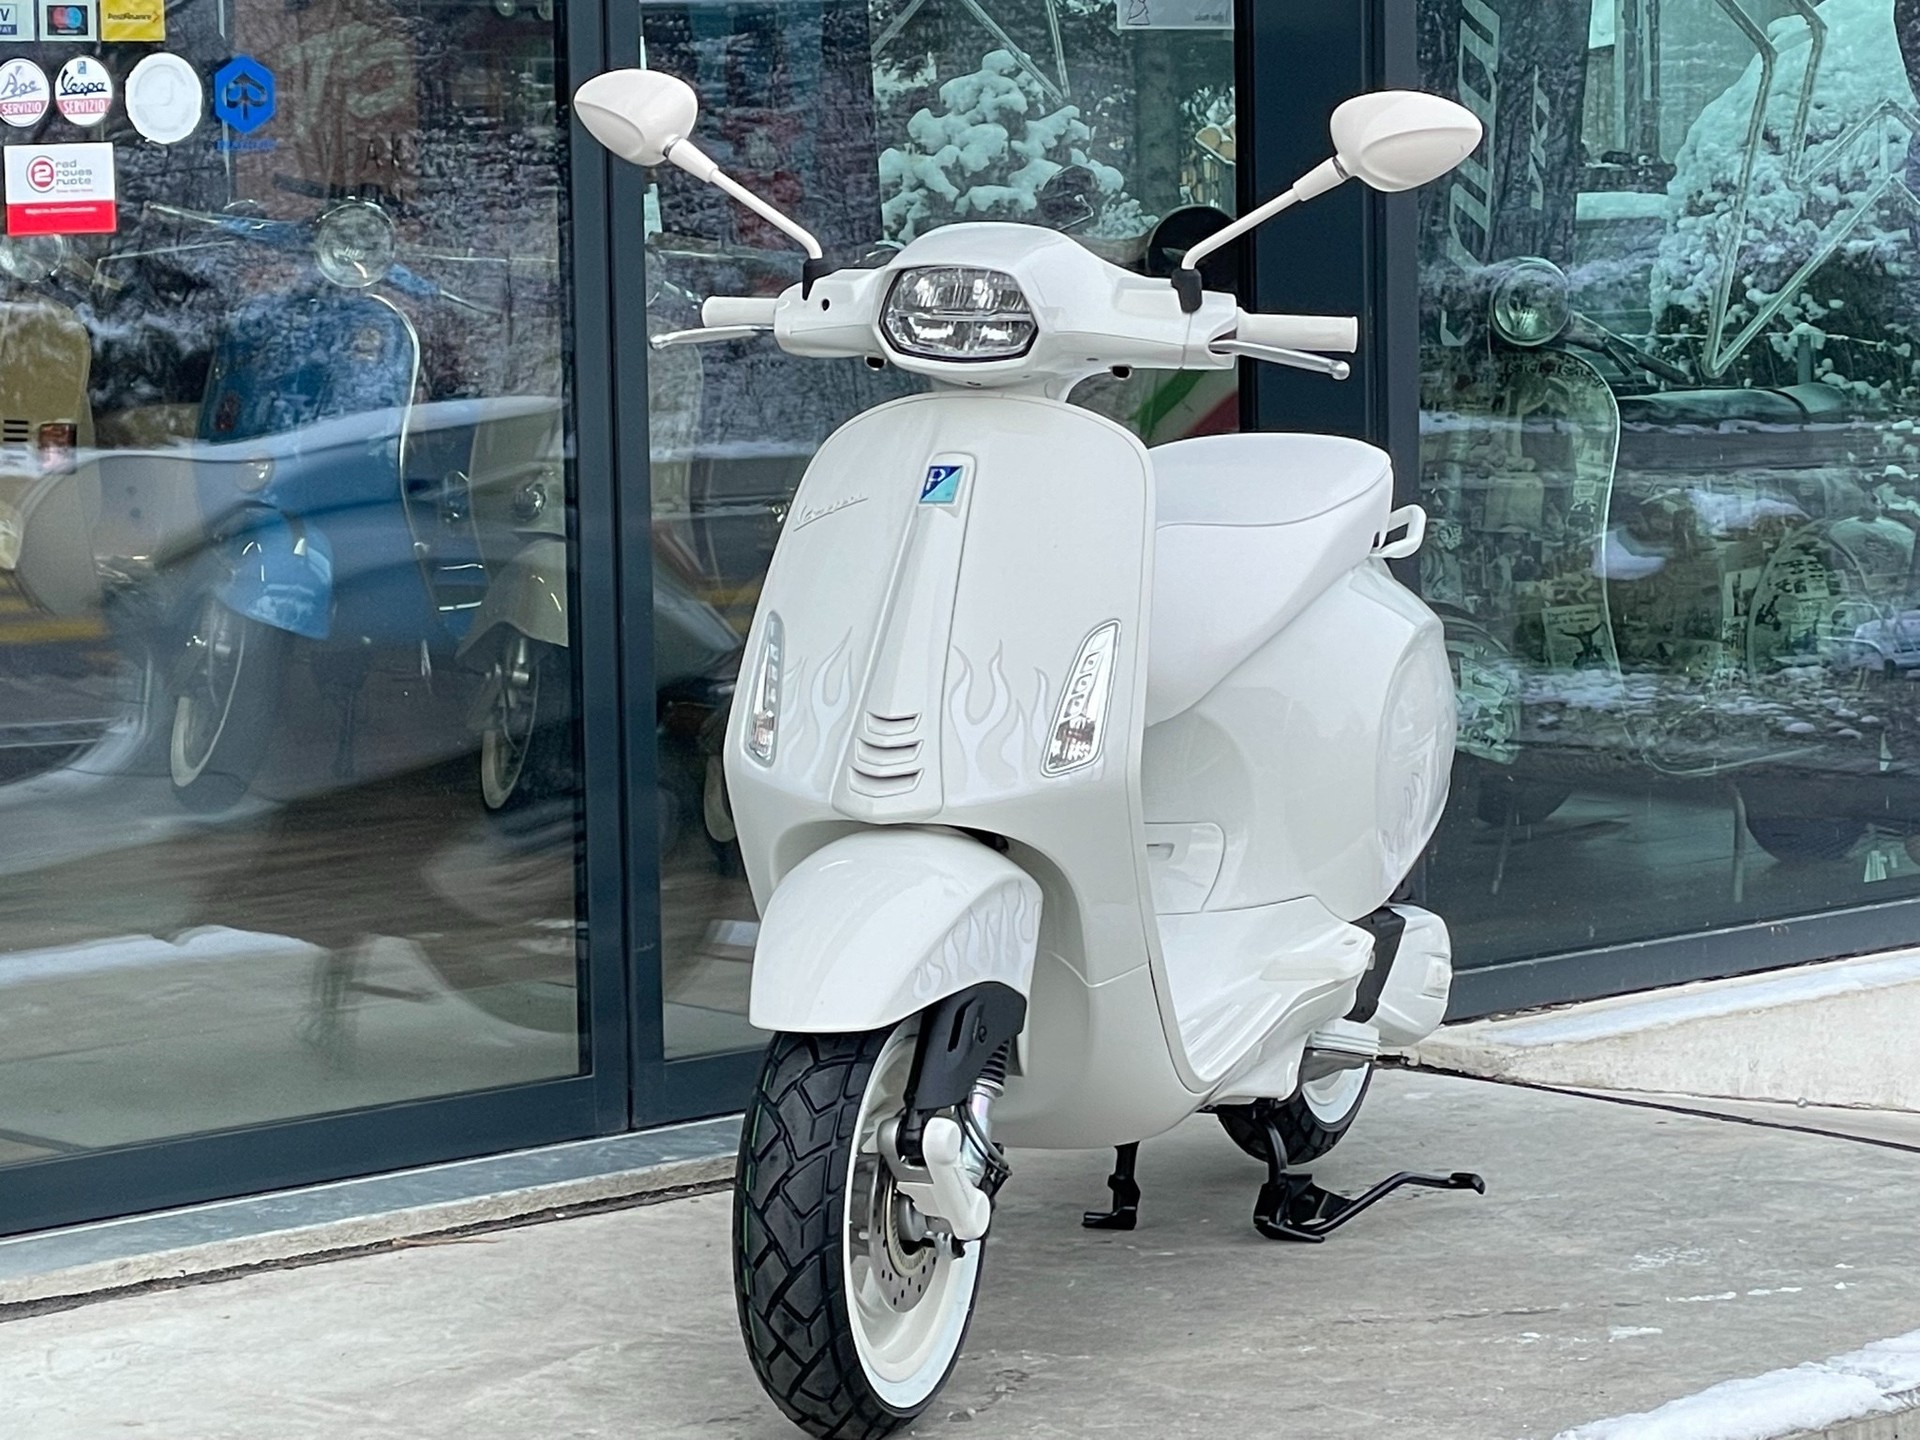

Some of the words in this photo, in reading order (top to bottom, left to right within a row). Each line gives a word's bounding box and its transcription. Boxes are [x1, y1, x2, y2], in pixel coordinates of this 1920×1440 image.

[60, 69, 107, 96] Vespa
[2, 102, 42, 114] SERVIZIO
[63, 100, 106, 113] SERVIZIO
